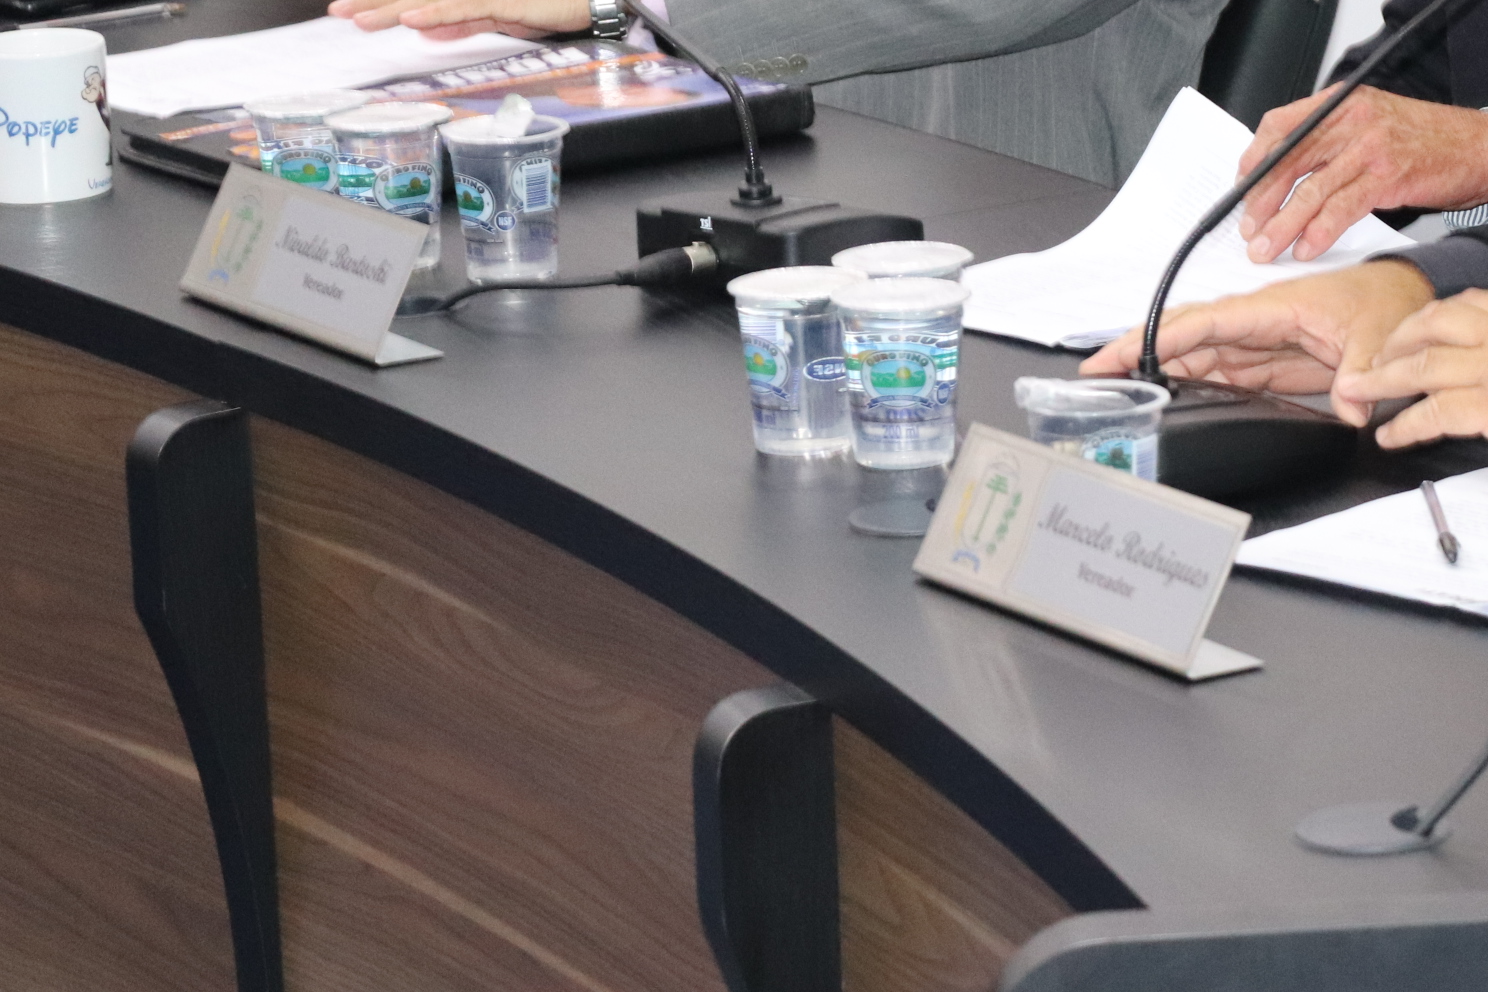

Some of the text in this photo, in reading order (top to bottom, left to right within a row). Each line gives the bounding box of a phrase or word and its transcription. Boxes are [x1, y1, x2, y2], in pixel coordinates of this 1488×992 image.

[411, 164, 433, 177] FINO
[302, 272, 344, 300] Vereador
[1037, 502, 1208, 589] Marcelo Rodrigues
[1078, 561, 1135, 599] Vereador
